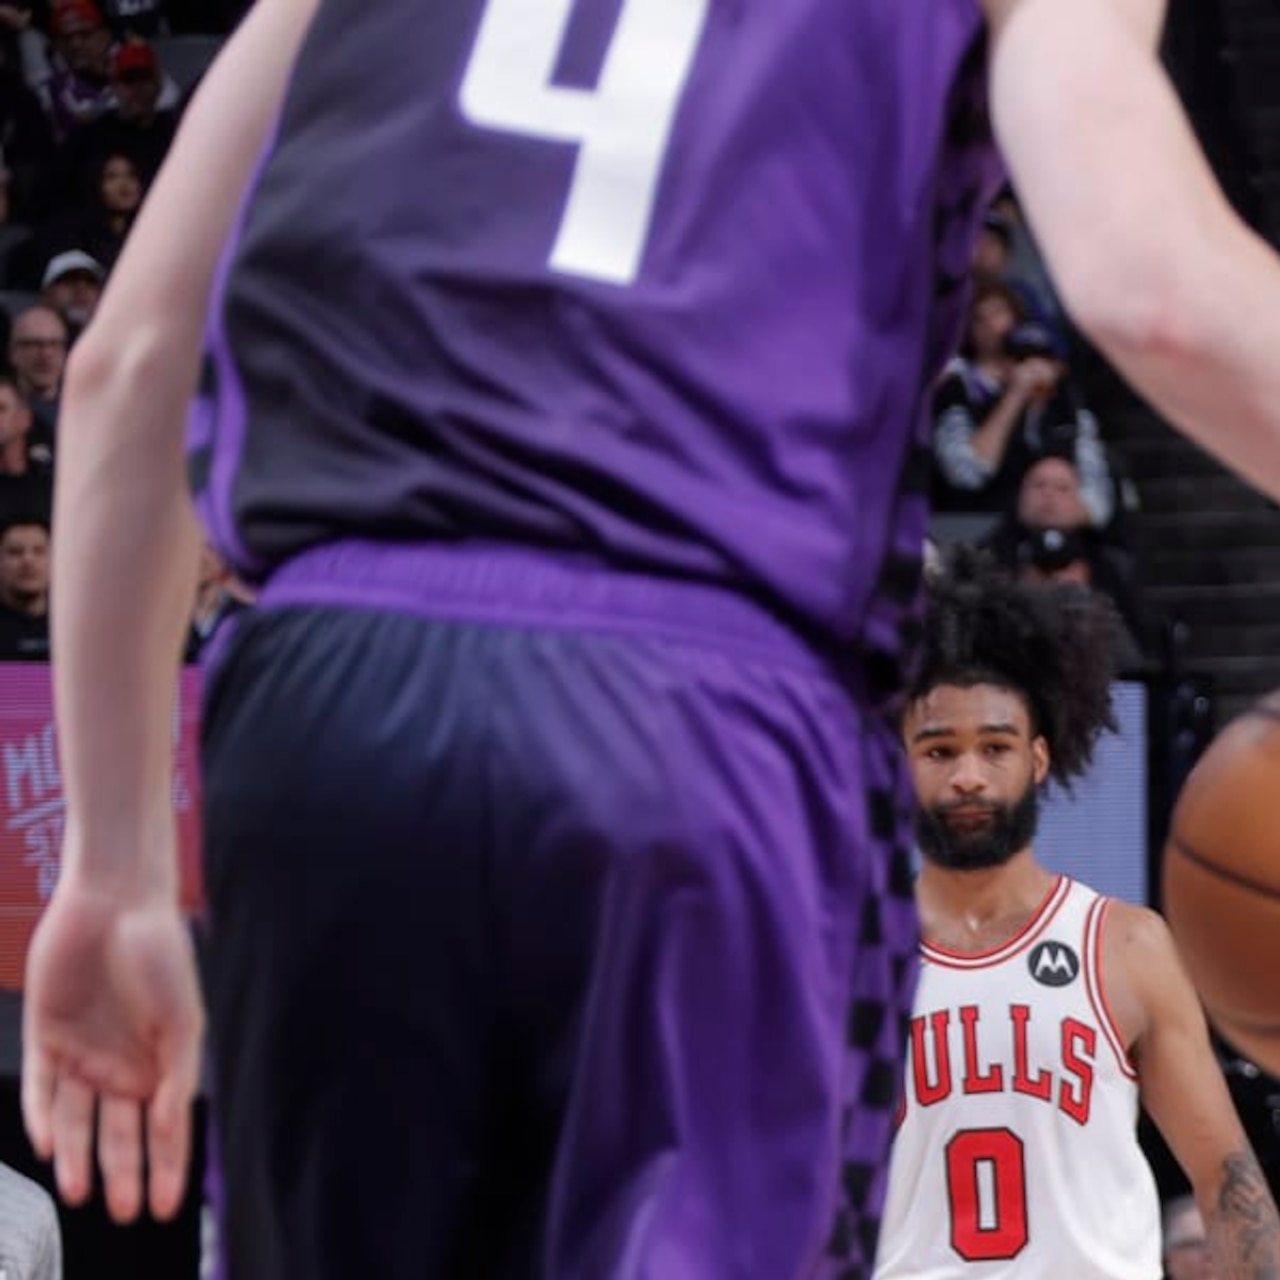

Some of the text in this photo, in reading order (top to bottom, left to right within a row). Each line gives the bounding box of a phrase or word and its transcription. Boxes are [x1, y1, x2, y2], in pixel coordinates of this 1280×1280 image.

[459, 0, 708, 284] 4
[898, 1003, 1097, 1126] ULLS
[945, 1126, 1030, 1262] 0
